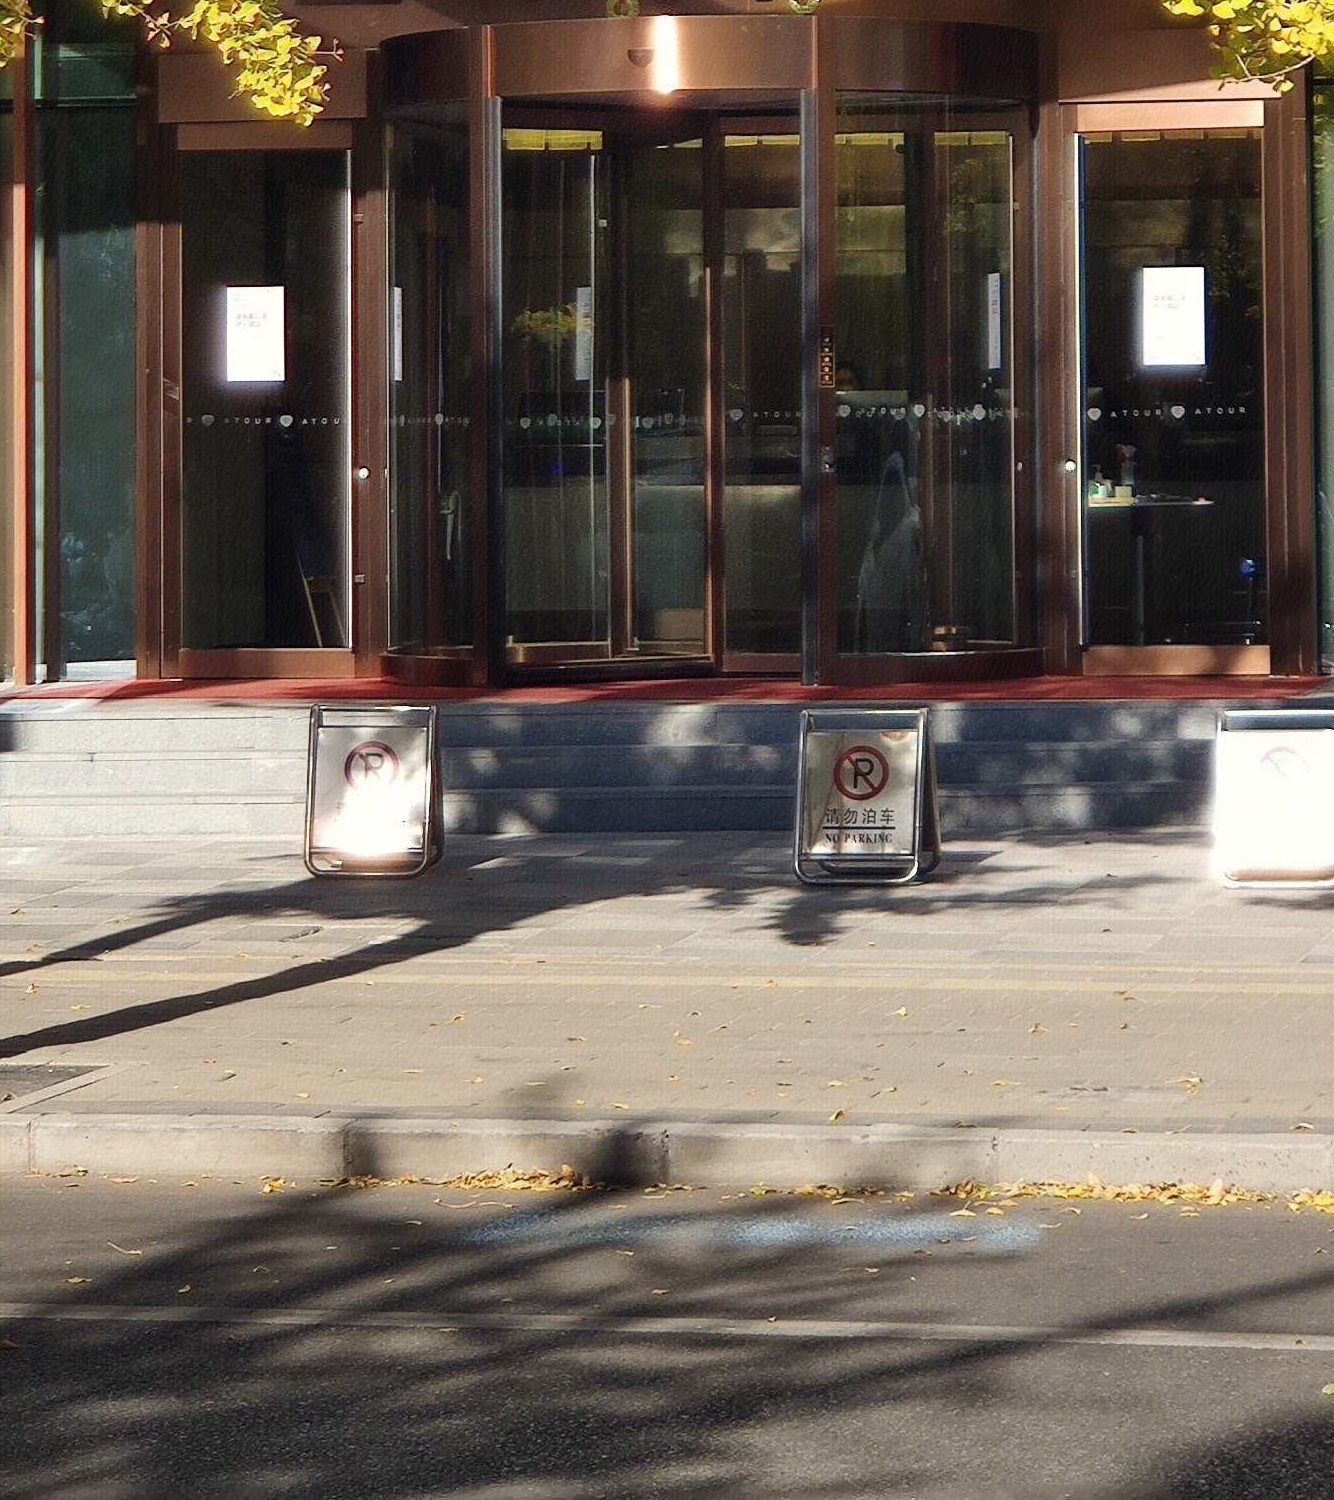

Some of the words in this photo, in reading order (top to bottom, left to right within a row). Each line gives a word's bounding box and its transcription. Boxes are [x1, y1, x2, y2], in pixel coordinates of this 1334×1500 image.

[1110, 409, 1162, 418] ATOUR
[1194, 406, 1246, 415] ATOUR
[223, 416, 272, 425] ATOUR
[825, 808, 895, 825] 请勿泊车
[824, 832, 840, 843] NO
[844, 832, 893, 844] PARKING
